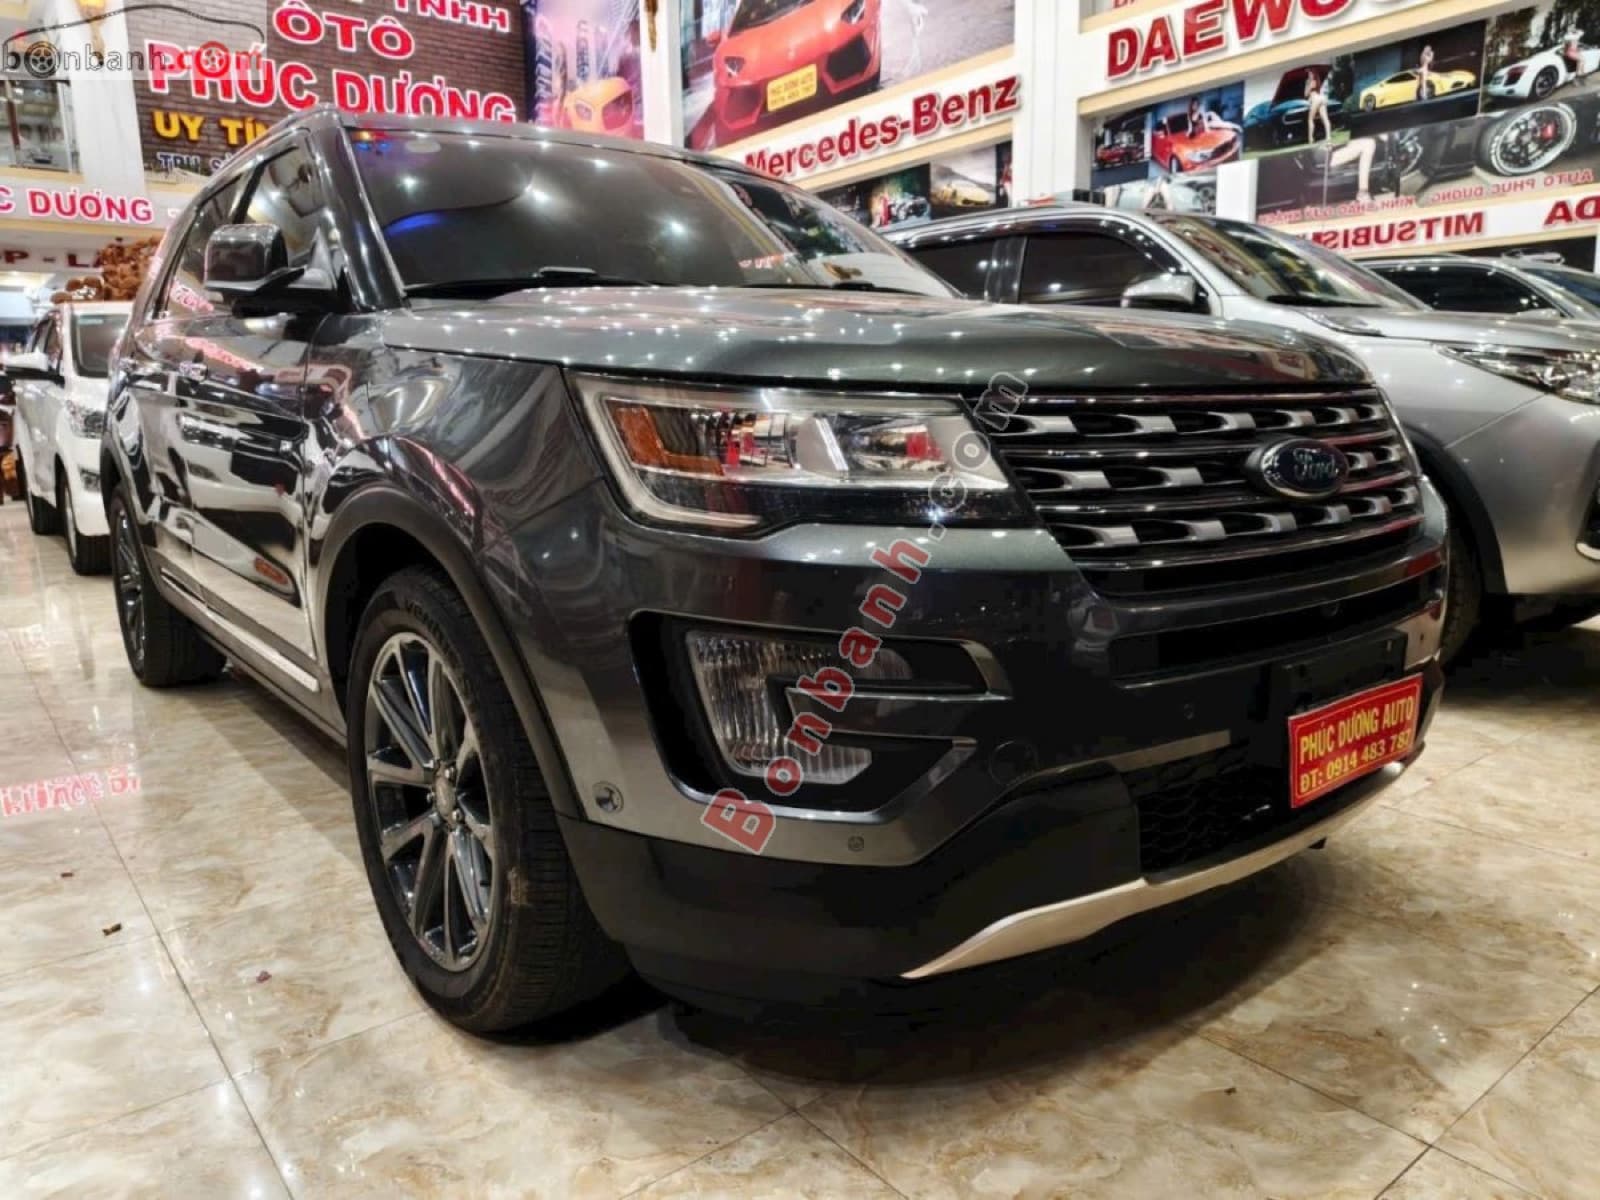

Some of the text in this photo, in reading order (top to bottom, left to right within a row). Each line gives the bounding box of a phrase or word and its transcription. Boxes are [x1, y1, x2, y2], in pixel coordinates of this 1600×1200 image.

[273, 0, 415, 59] ÔTÔ
[144, 40, 319, 111] PHÚC
[332, 69, 516, 123] DƯƠNG
[153, 109, 204, 141] UY
[745, 76, 1018, 177] Mercedes-Benz
[27, 188, 154, 223] DƯƠNG
[1300, 696, 1414, 764] PHÚC DƯƠNG AUTO
[1326, 749, 1358, 779] 0914
[1360, 738, 1387, 763] 483
